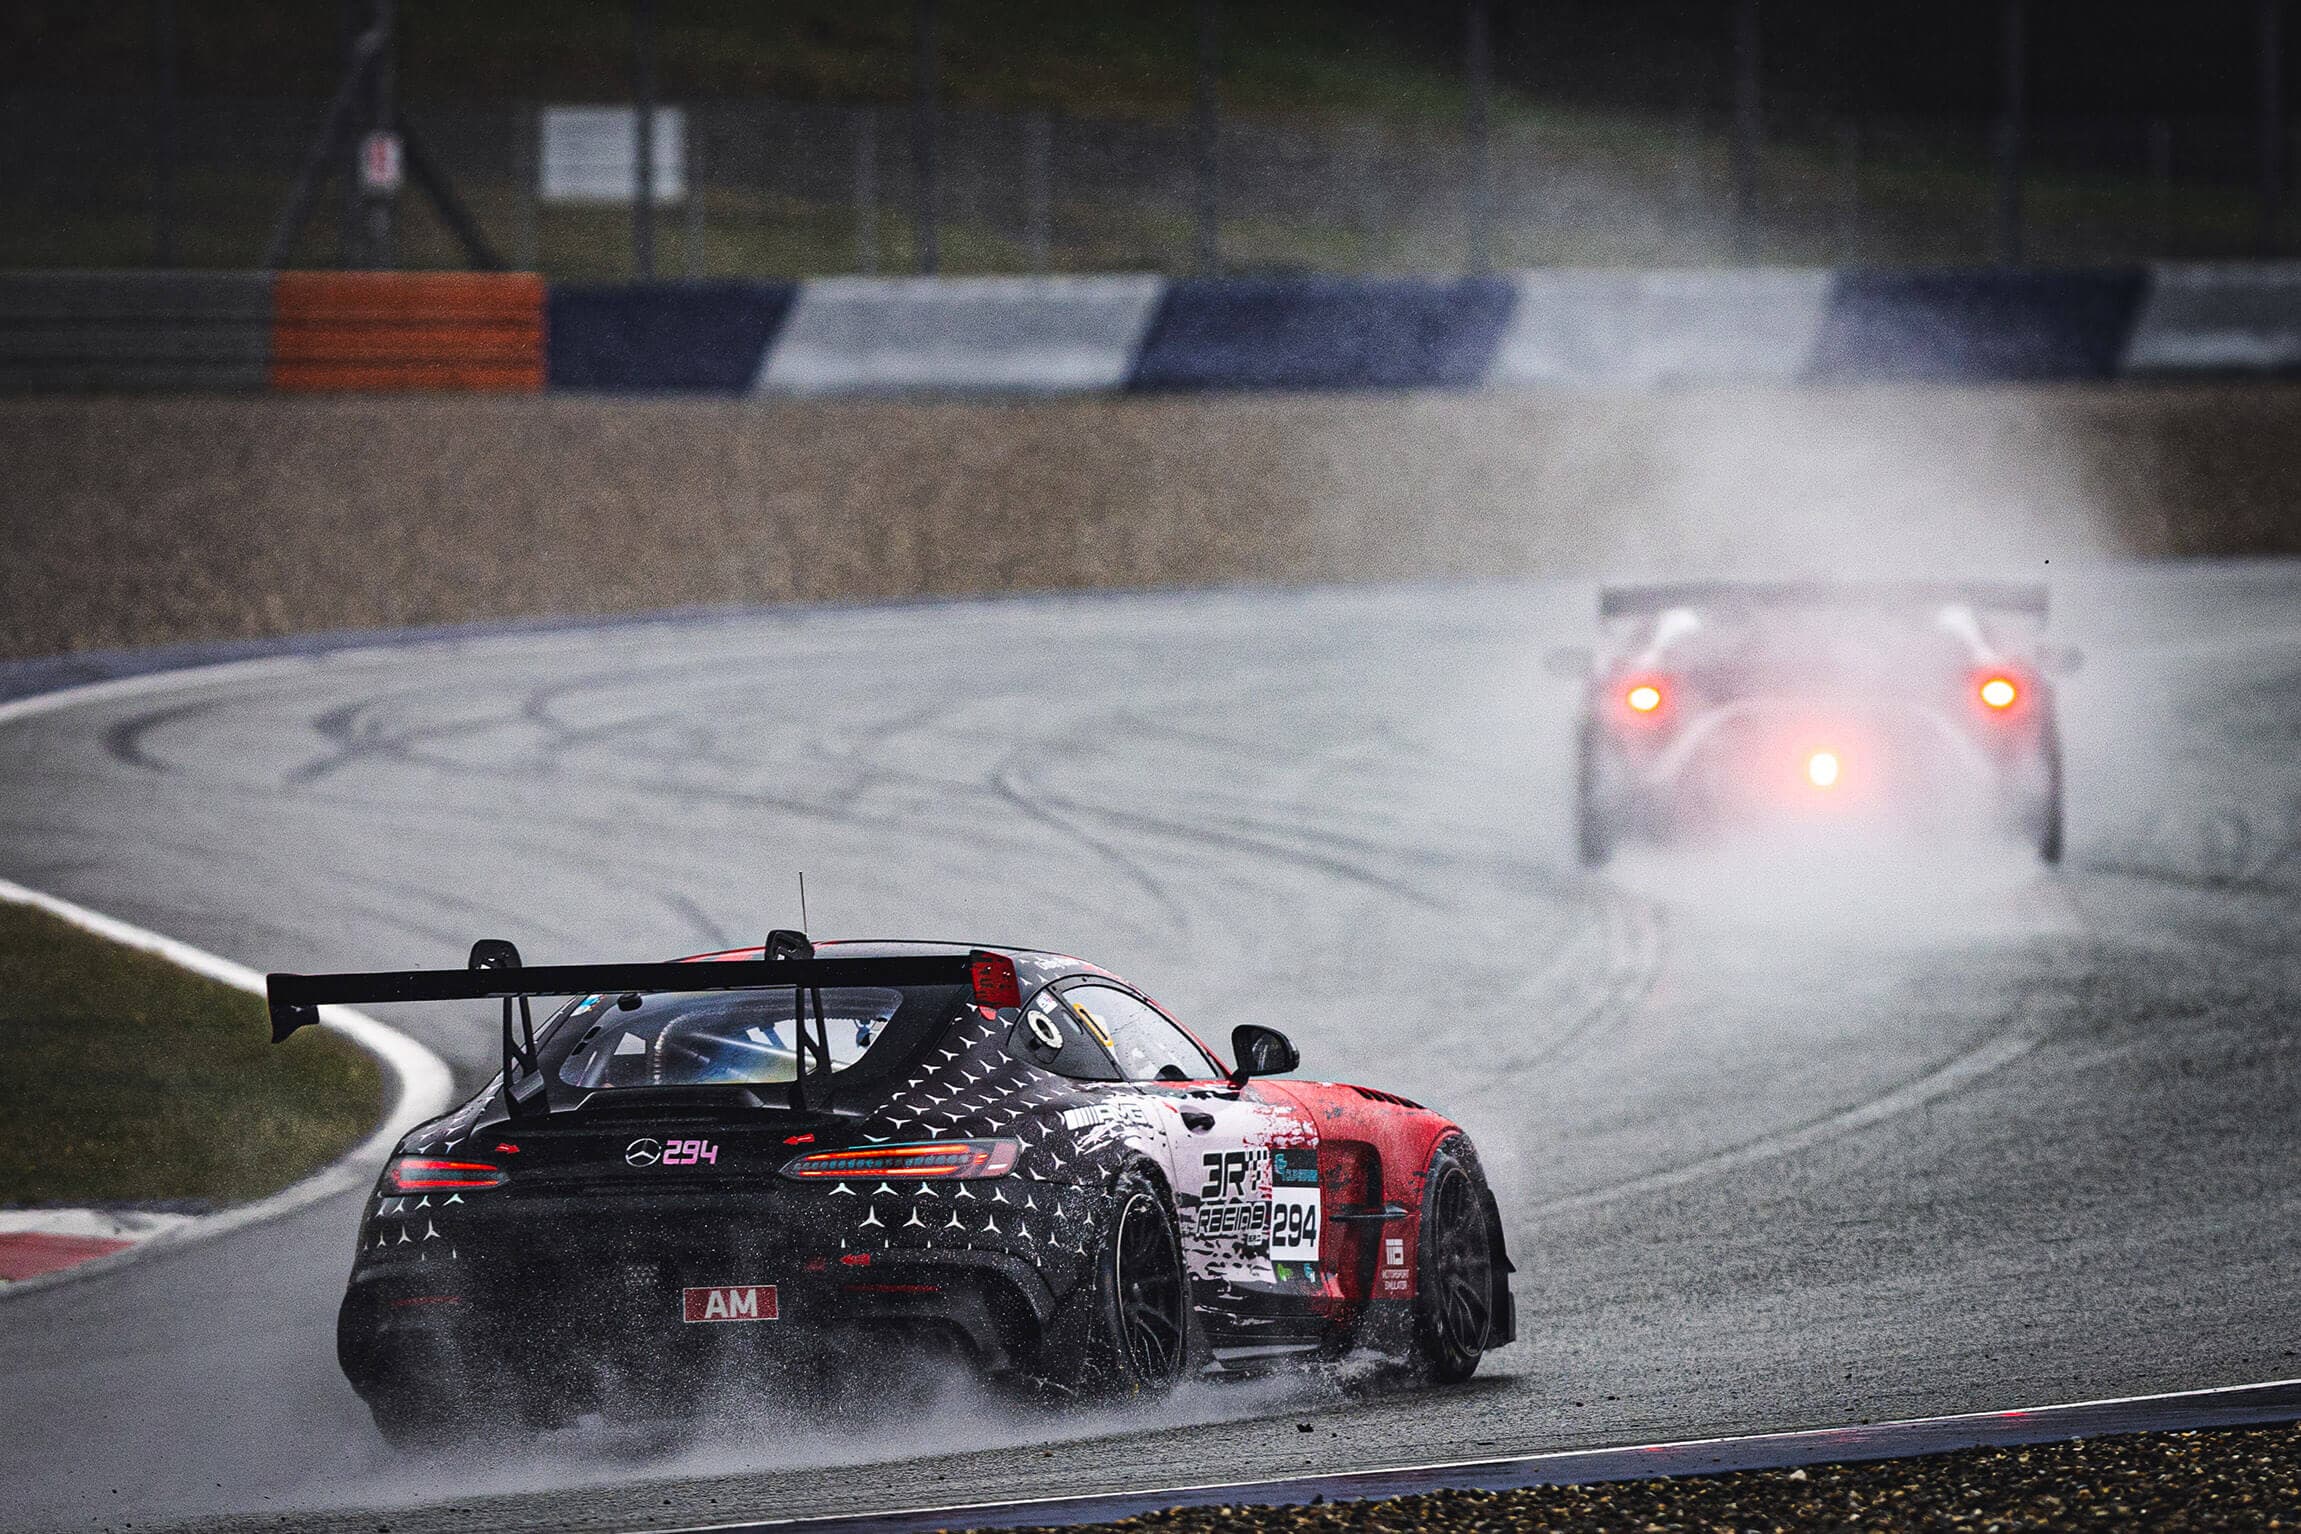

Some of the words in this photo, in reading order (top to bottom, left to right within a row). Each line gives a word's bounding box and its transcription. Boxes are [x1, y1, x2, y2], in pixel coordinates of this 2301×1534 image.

[662, 1139, 719, 1165] 294
[1201, 1150, 1249, 1198] 3R
[1272, 1203, 1317, 1247] 294
[704, 1288, 758, 1319] AM
